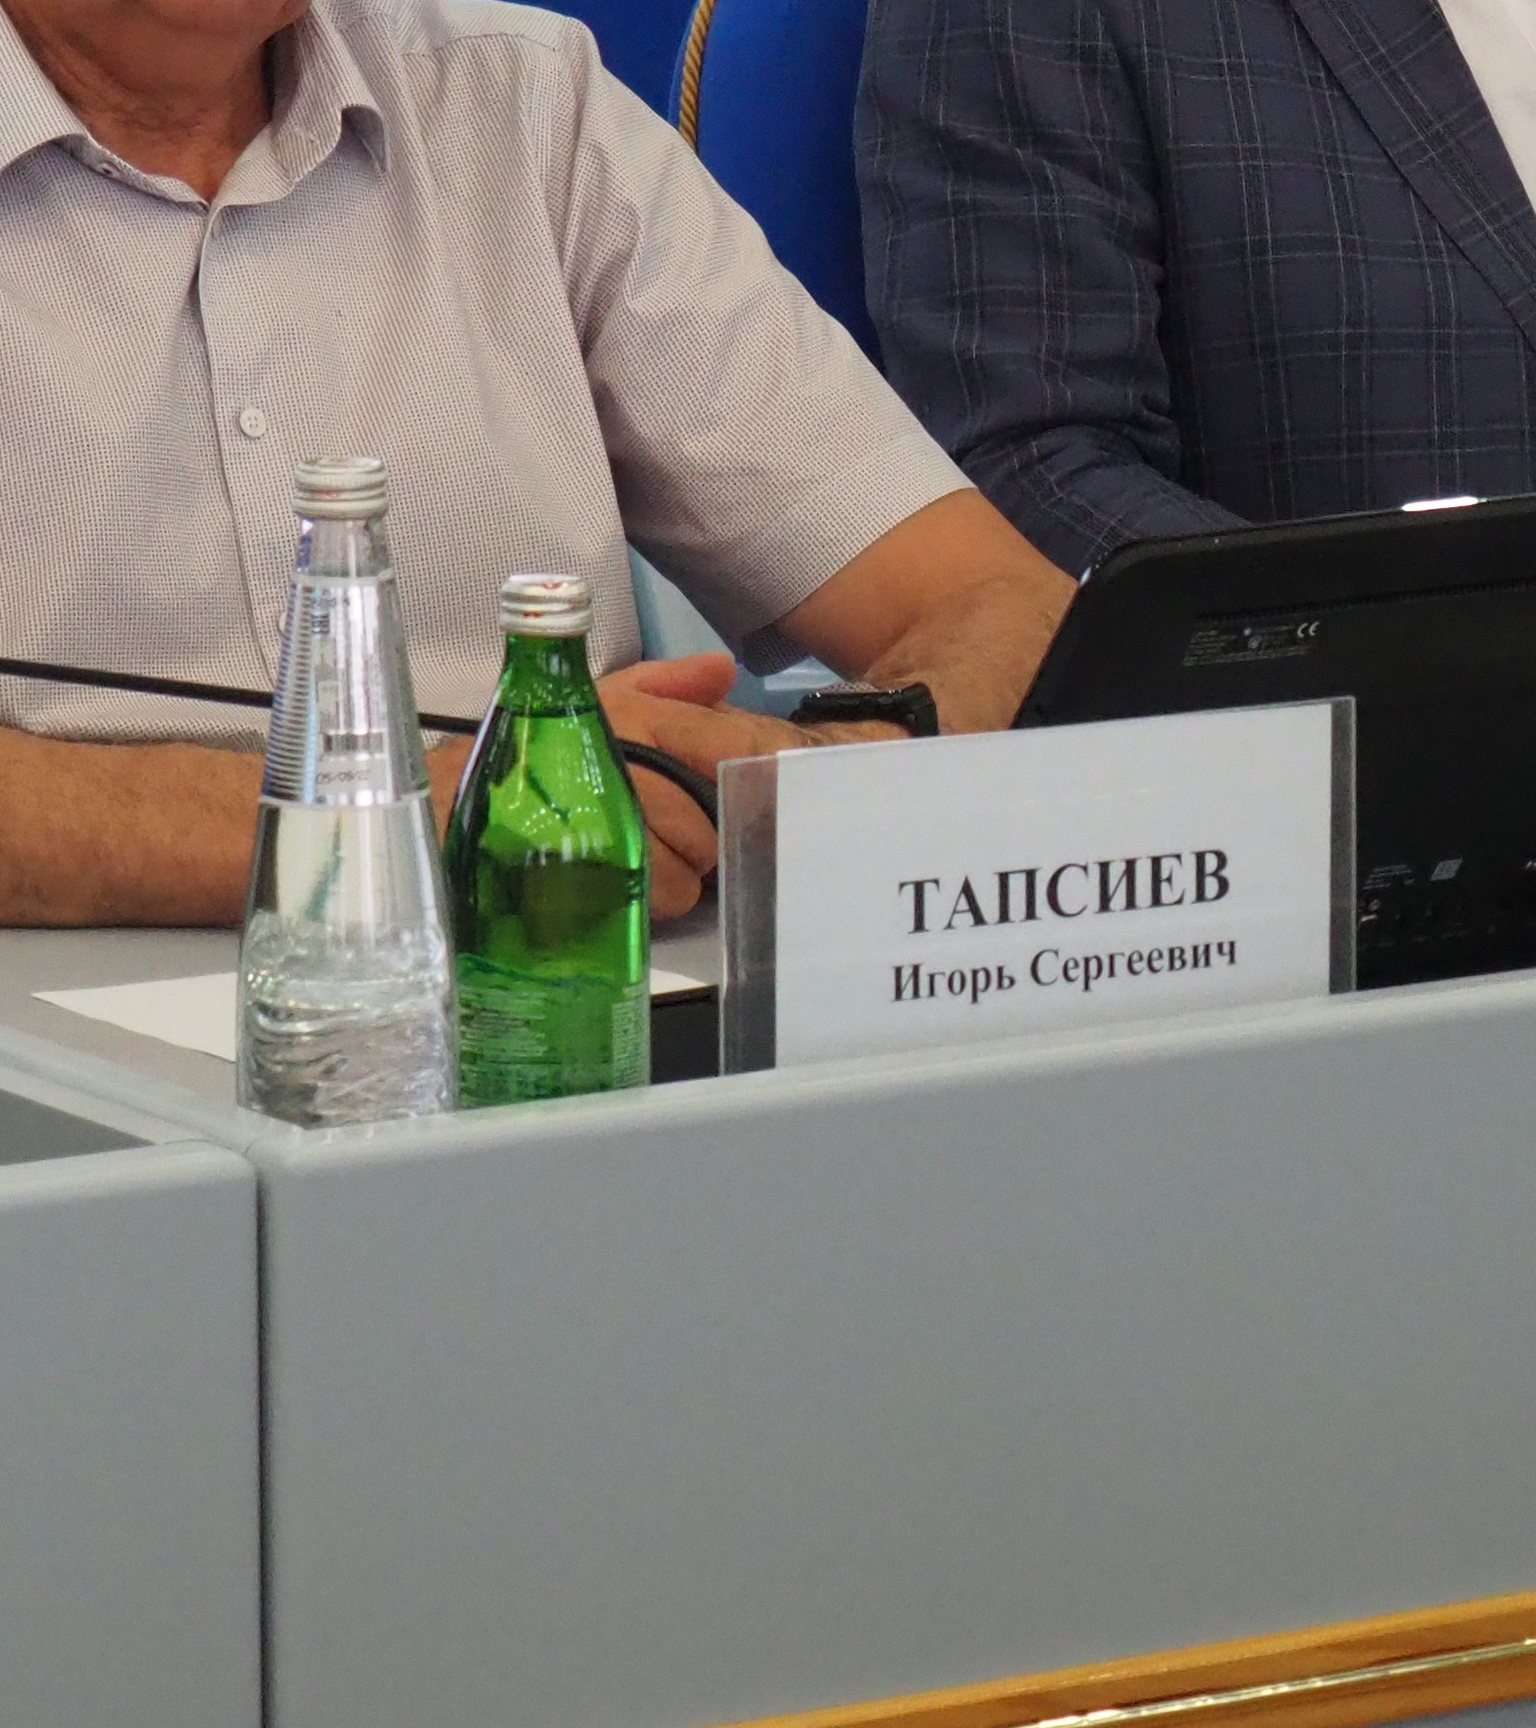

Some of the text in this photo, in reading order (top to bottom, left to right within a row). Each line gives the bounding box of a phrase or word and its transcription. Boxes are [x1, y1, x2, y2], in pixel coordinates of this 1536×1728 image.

[897, 848, 1231, 936] ТАПСИЕВ
[892, 939, 1238, 1005] Игорь Сергеевич
